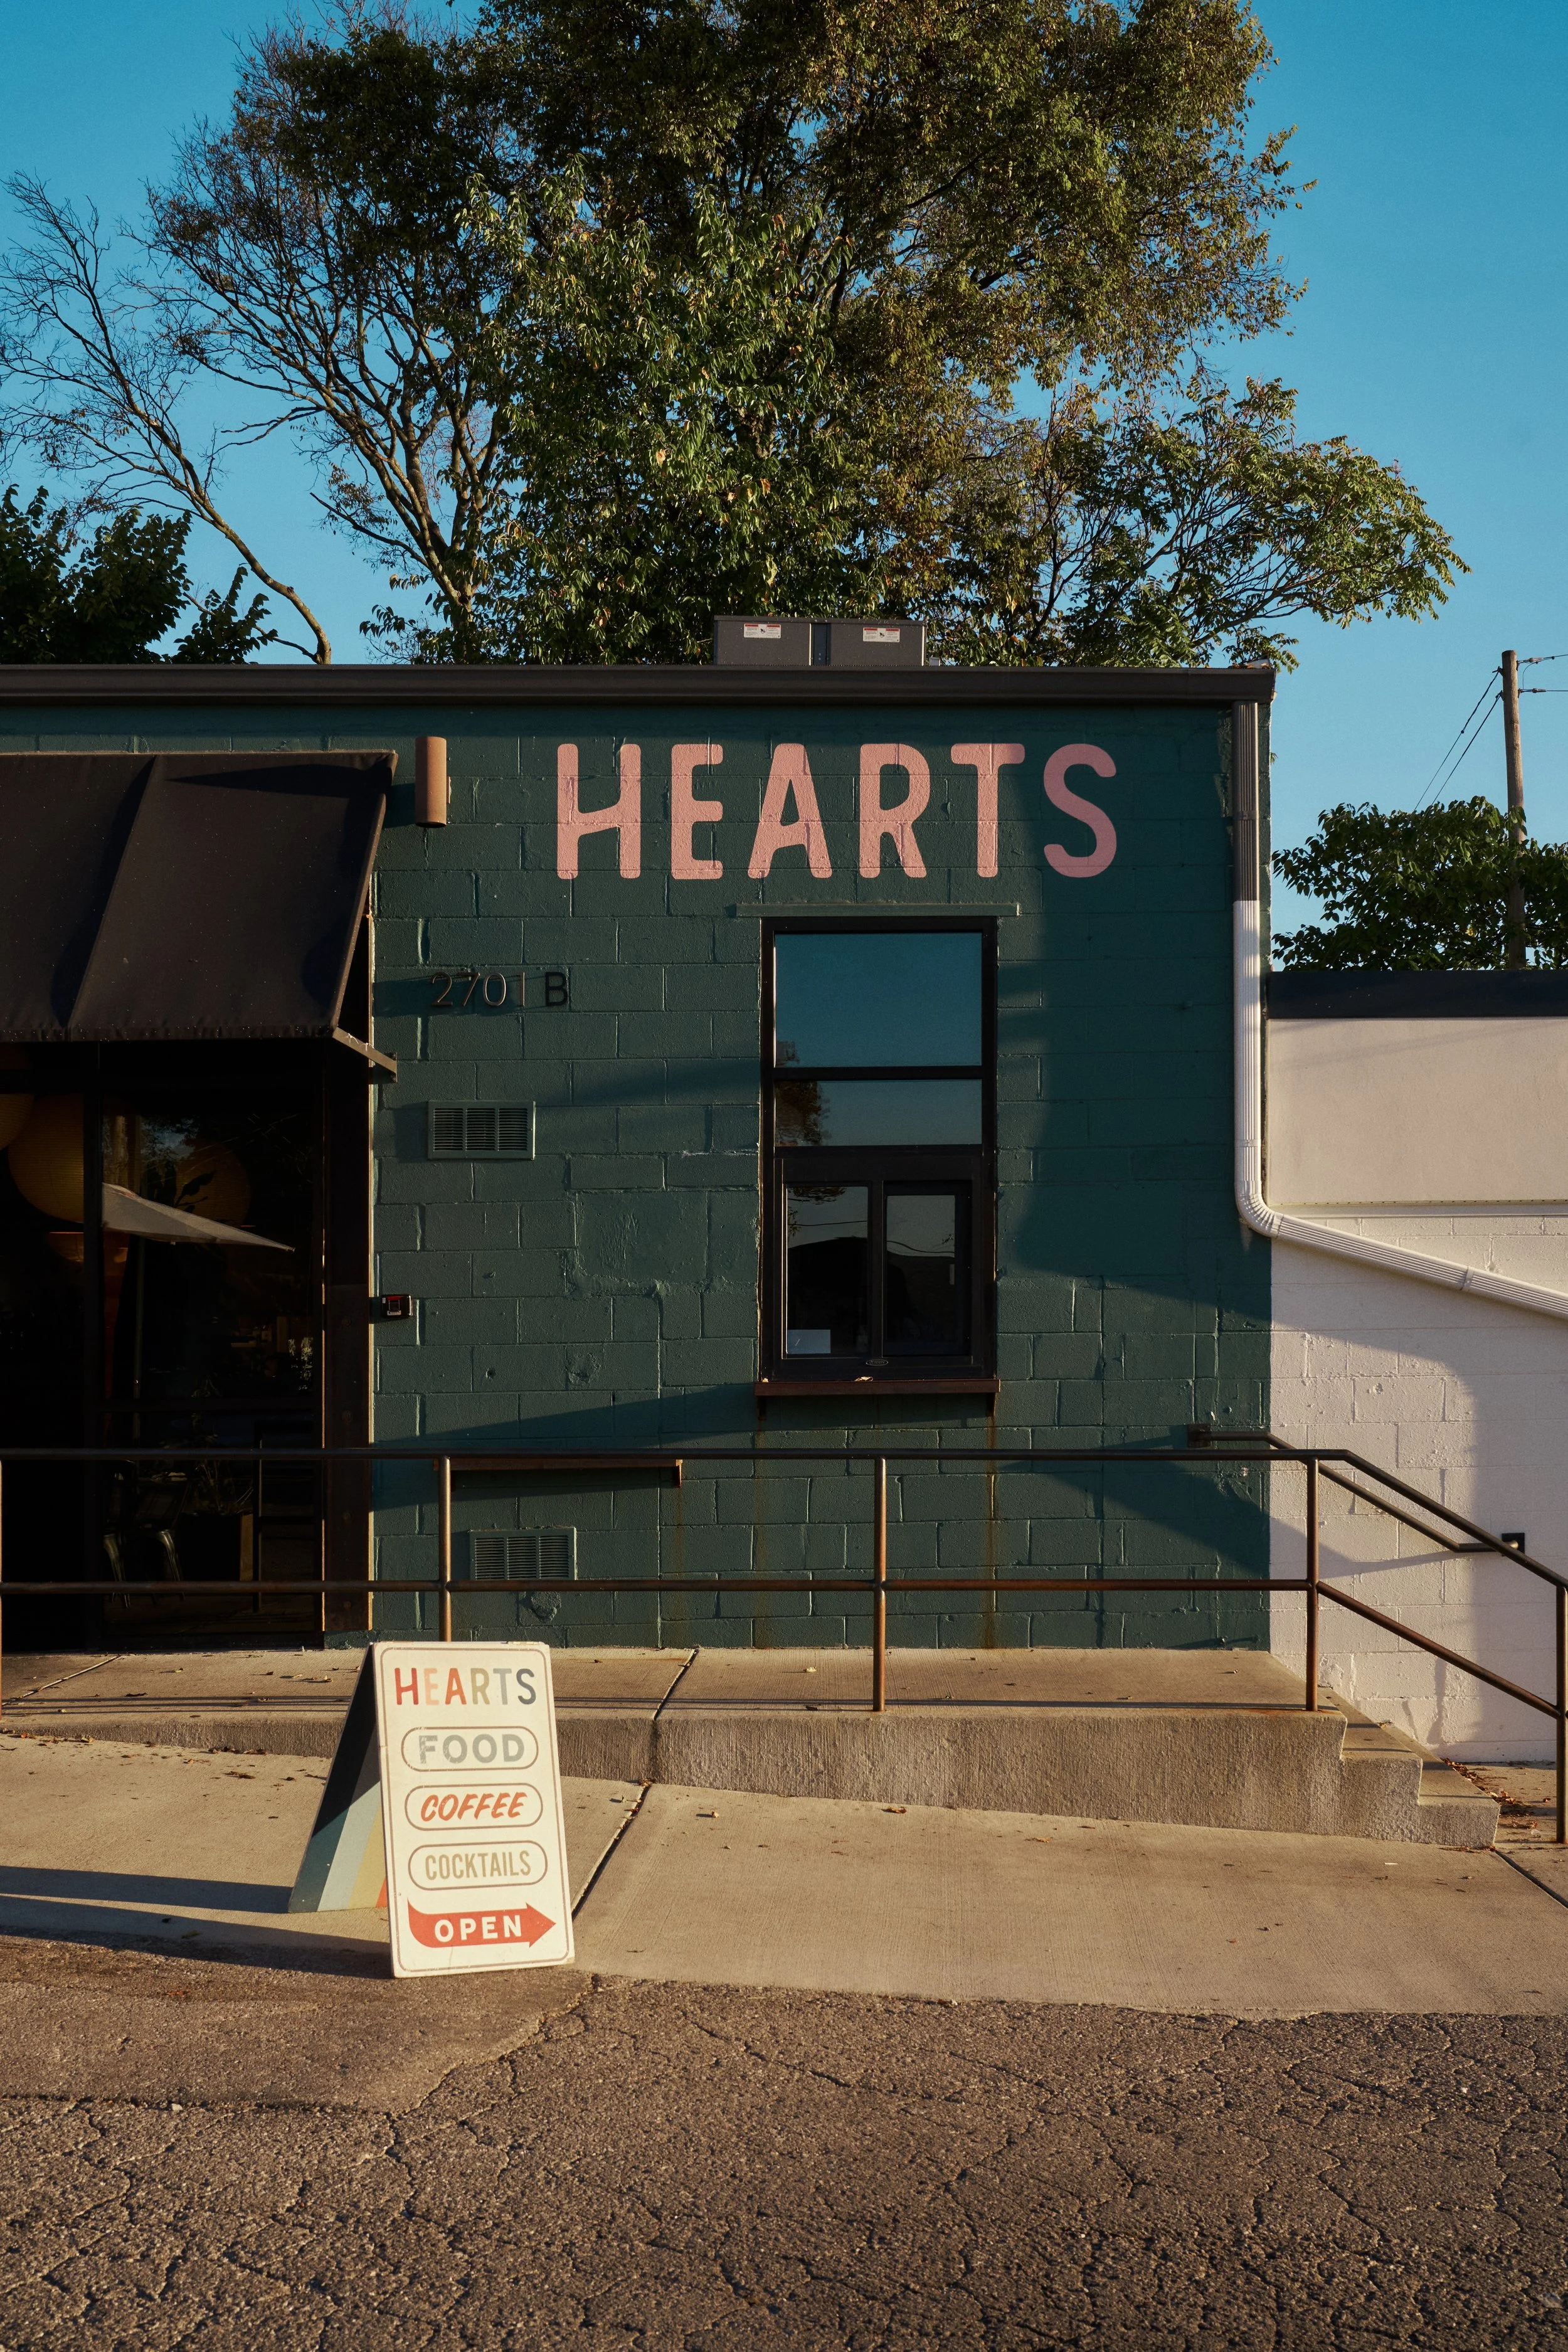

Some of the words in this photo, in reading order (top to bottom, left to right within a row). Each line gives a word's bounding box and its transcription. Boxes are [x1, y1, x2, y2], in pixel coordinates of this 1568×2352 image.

[556, 743, 1117, 879] HEARTS
[430, 972, 526, 1007] 2701
[544, 972, 569, 1007] B
[394, 1667, 537, 1706] HEARTS
[418, 1734, 525, 1764] FOOD
[420, 1791, 527, 1822] COFFEE
[425, 1850, 532, 1881] COCKTAILS
[434, 1914, 522, 1943] OPEN
